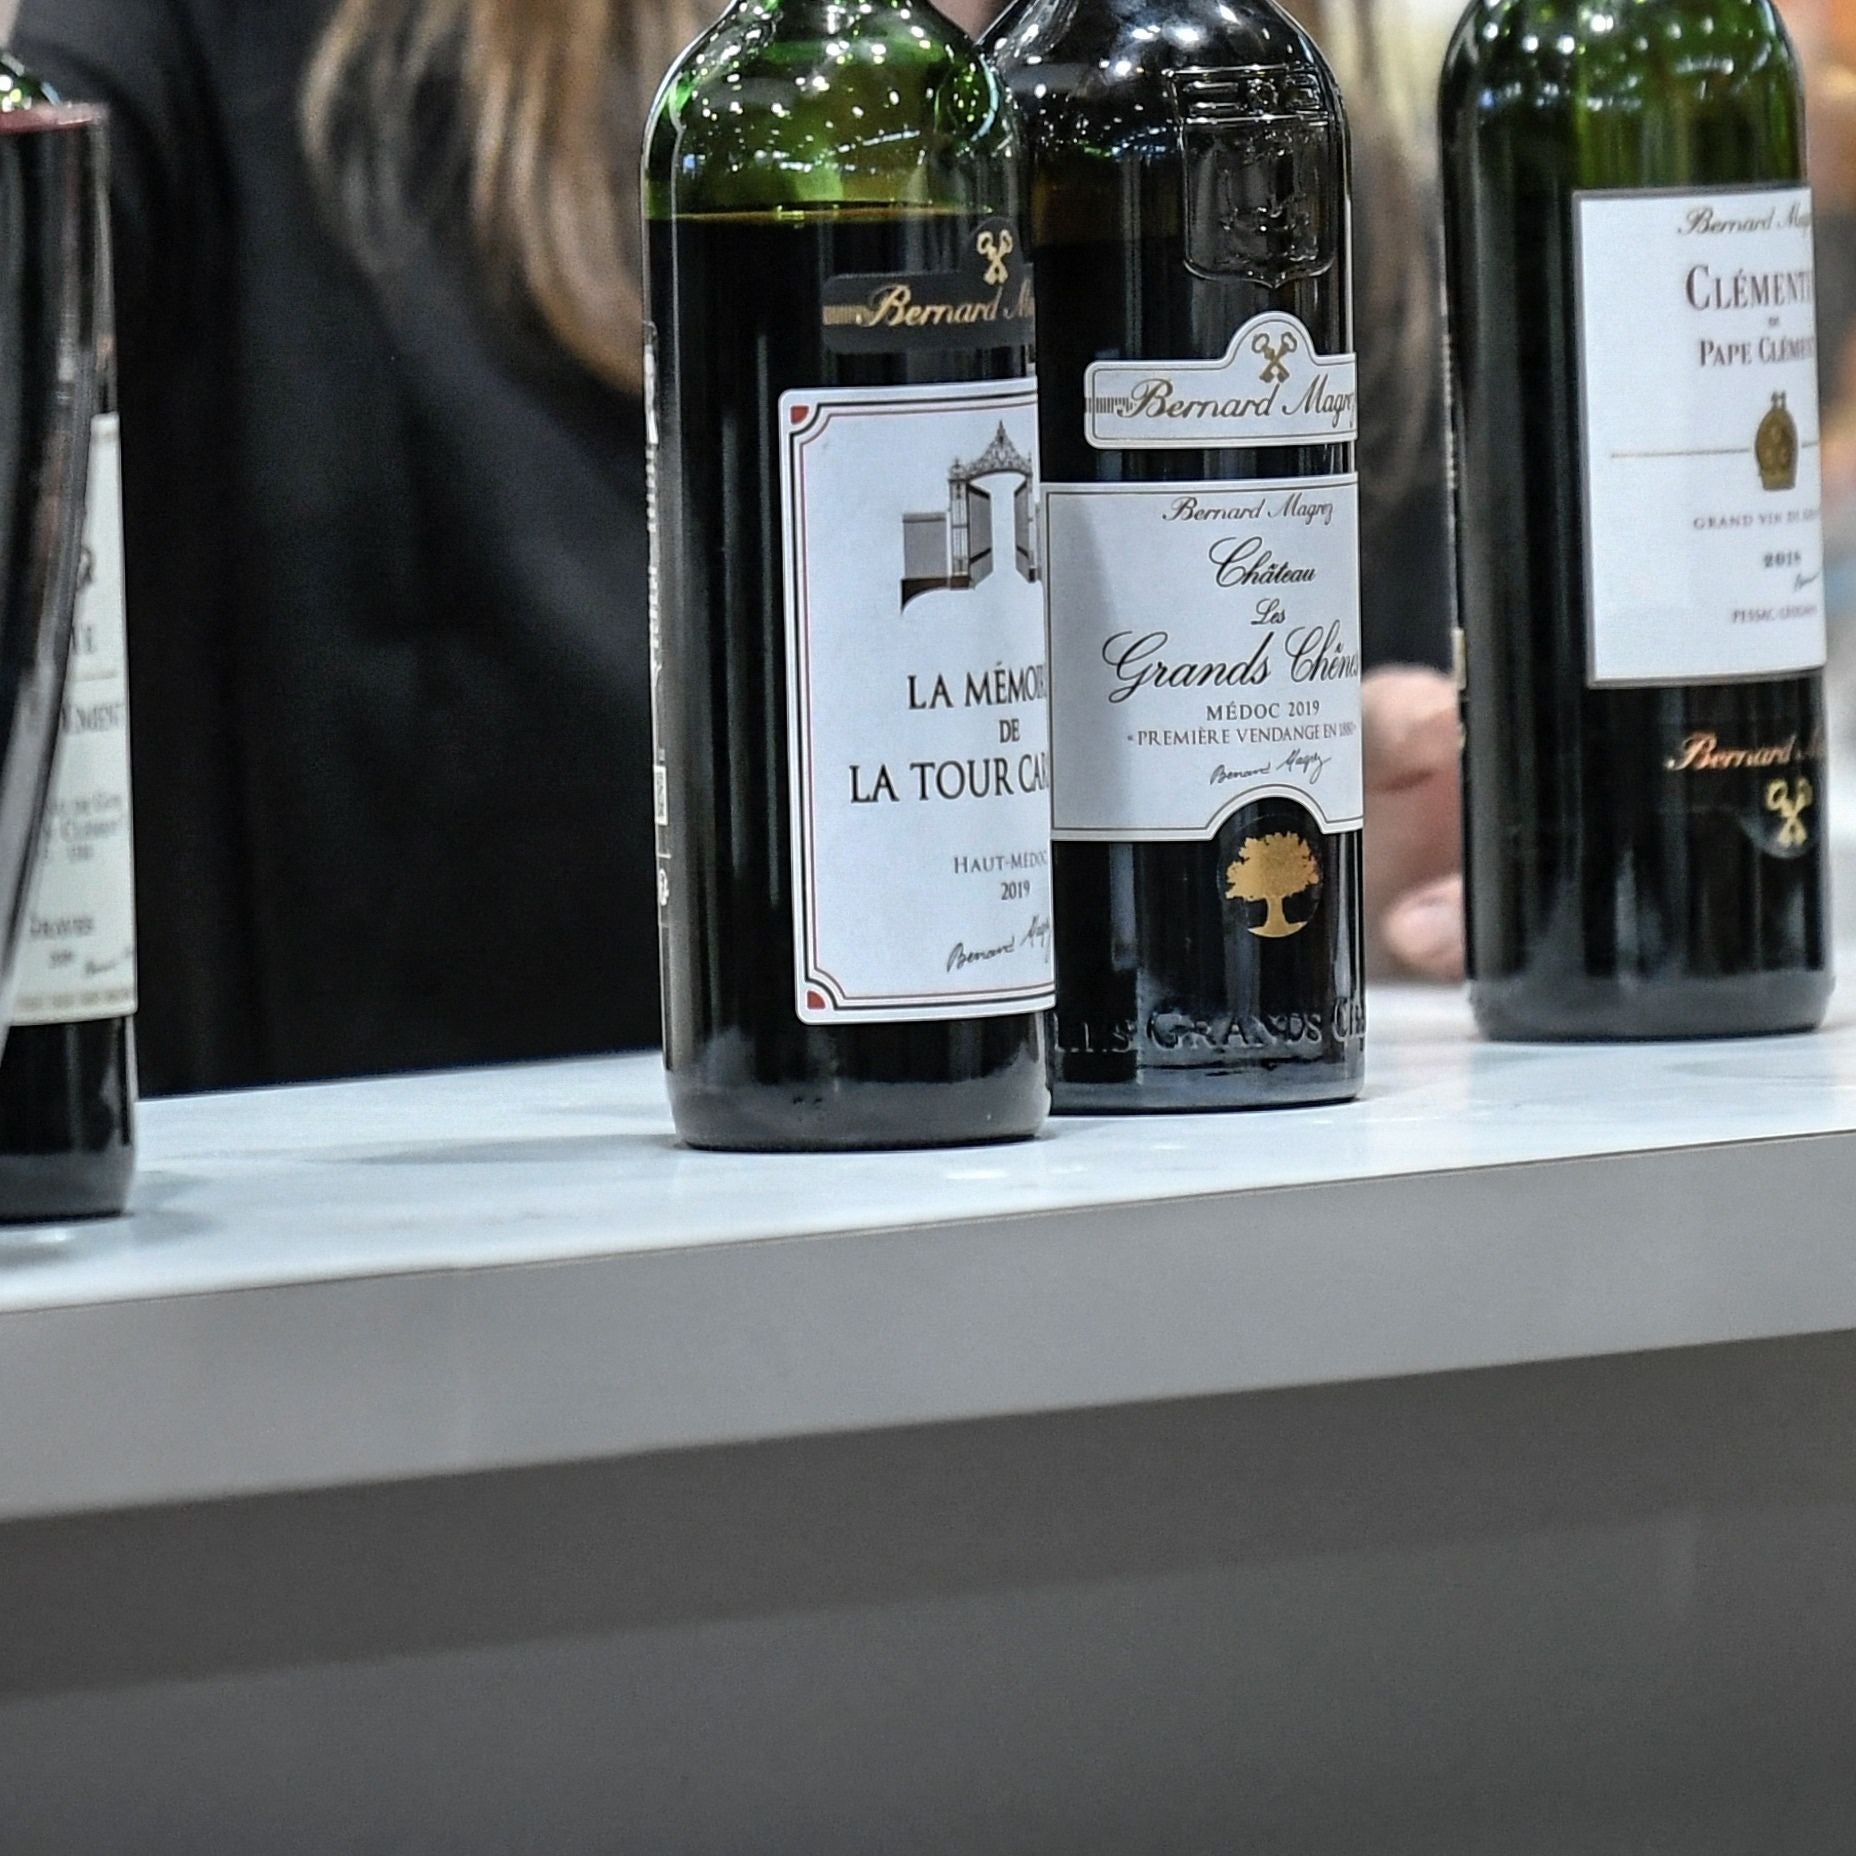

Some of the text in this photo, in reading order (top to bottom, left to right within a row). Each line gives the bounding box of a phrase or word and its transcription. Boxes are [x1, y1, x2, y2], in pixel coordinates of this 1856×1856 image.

[1677, 205, 1776, 235] Bernard
[854, 283, 1004, 328] Bernard
[1699, 337, 1754, 368] PAPE
[1115, 377, 1281, 419] Bernard
[1161, 495, 1267, 522] Bernard
[1208, 536, 1318, 589] Château
[1249, 597, 1288, 627] Les
[1101, 630, 1276, 705] Grands
[907, 672, 955, 711] LA
[1205, 699, 1321, 722] MÉDOC 2019
[998, 717, 1021, 744] DE
[1236, 724, 1322, 745] VENDANGE
[1665, 730, 1797, 772] Bernard
[848, 763, 901, 805] LA
[908, 756, 1015, 802] TOUR
[999, 879, 1031, 901] 2019
